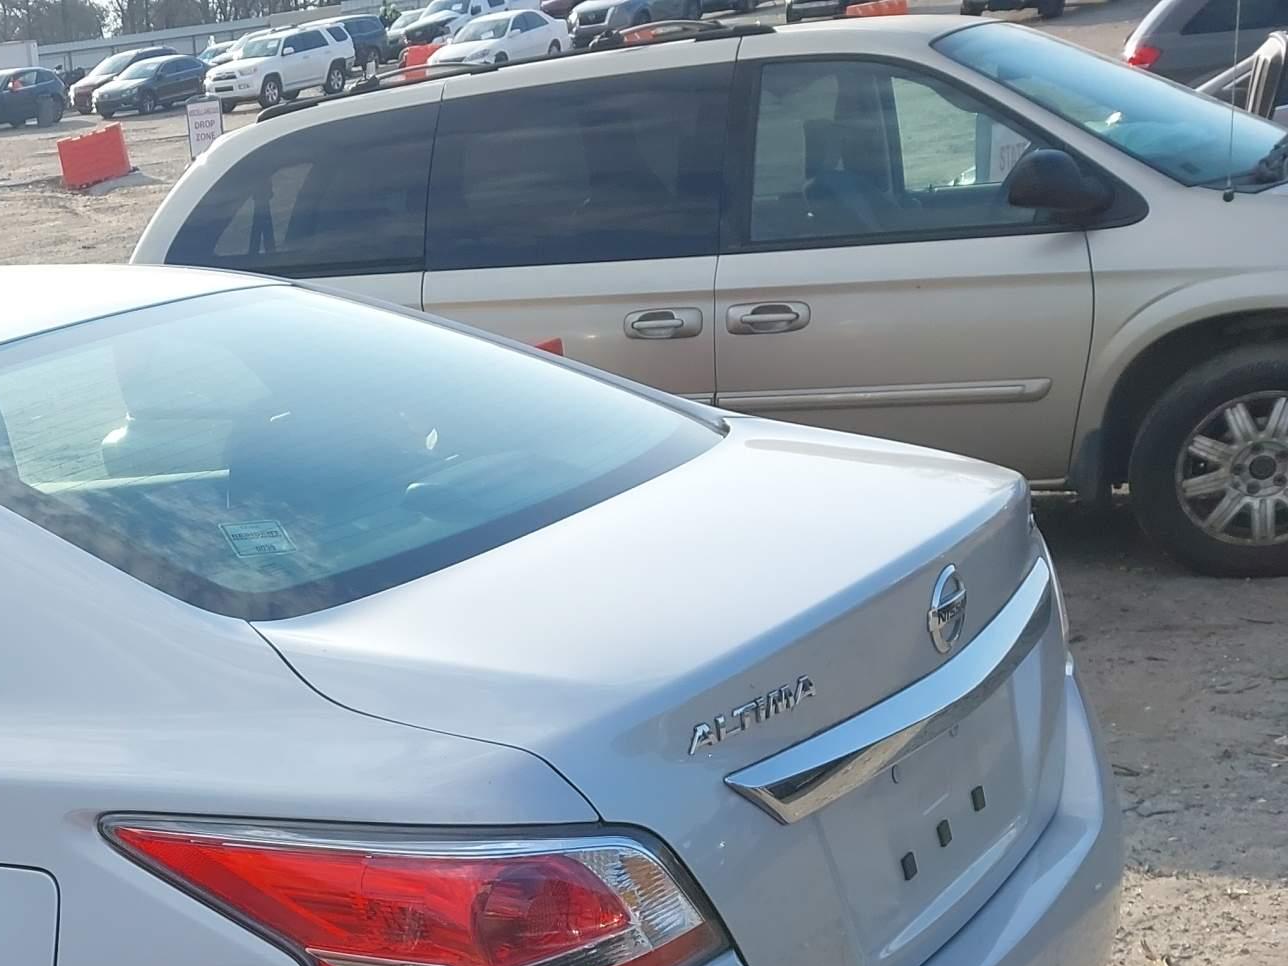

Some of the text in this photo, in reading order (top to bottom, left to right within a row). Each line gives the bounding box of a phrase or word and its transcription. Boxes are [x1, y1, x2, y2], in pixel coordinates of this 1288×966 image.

[194, 119, 216, 130] DROP
[196, 131, 216, 142] ZONE
[688, 674, 817, 755] ALTIMA
